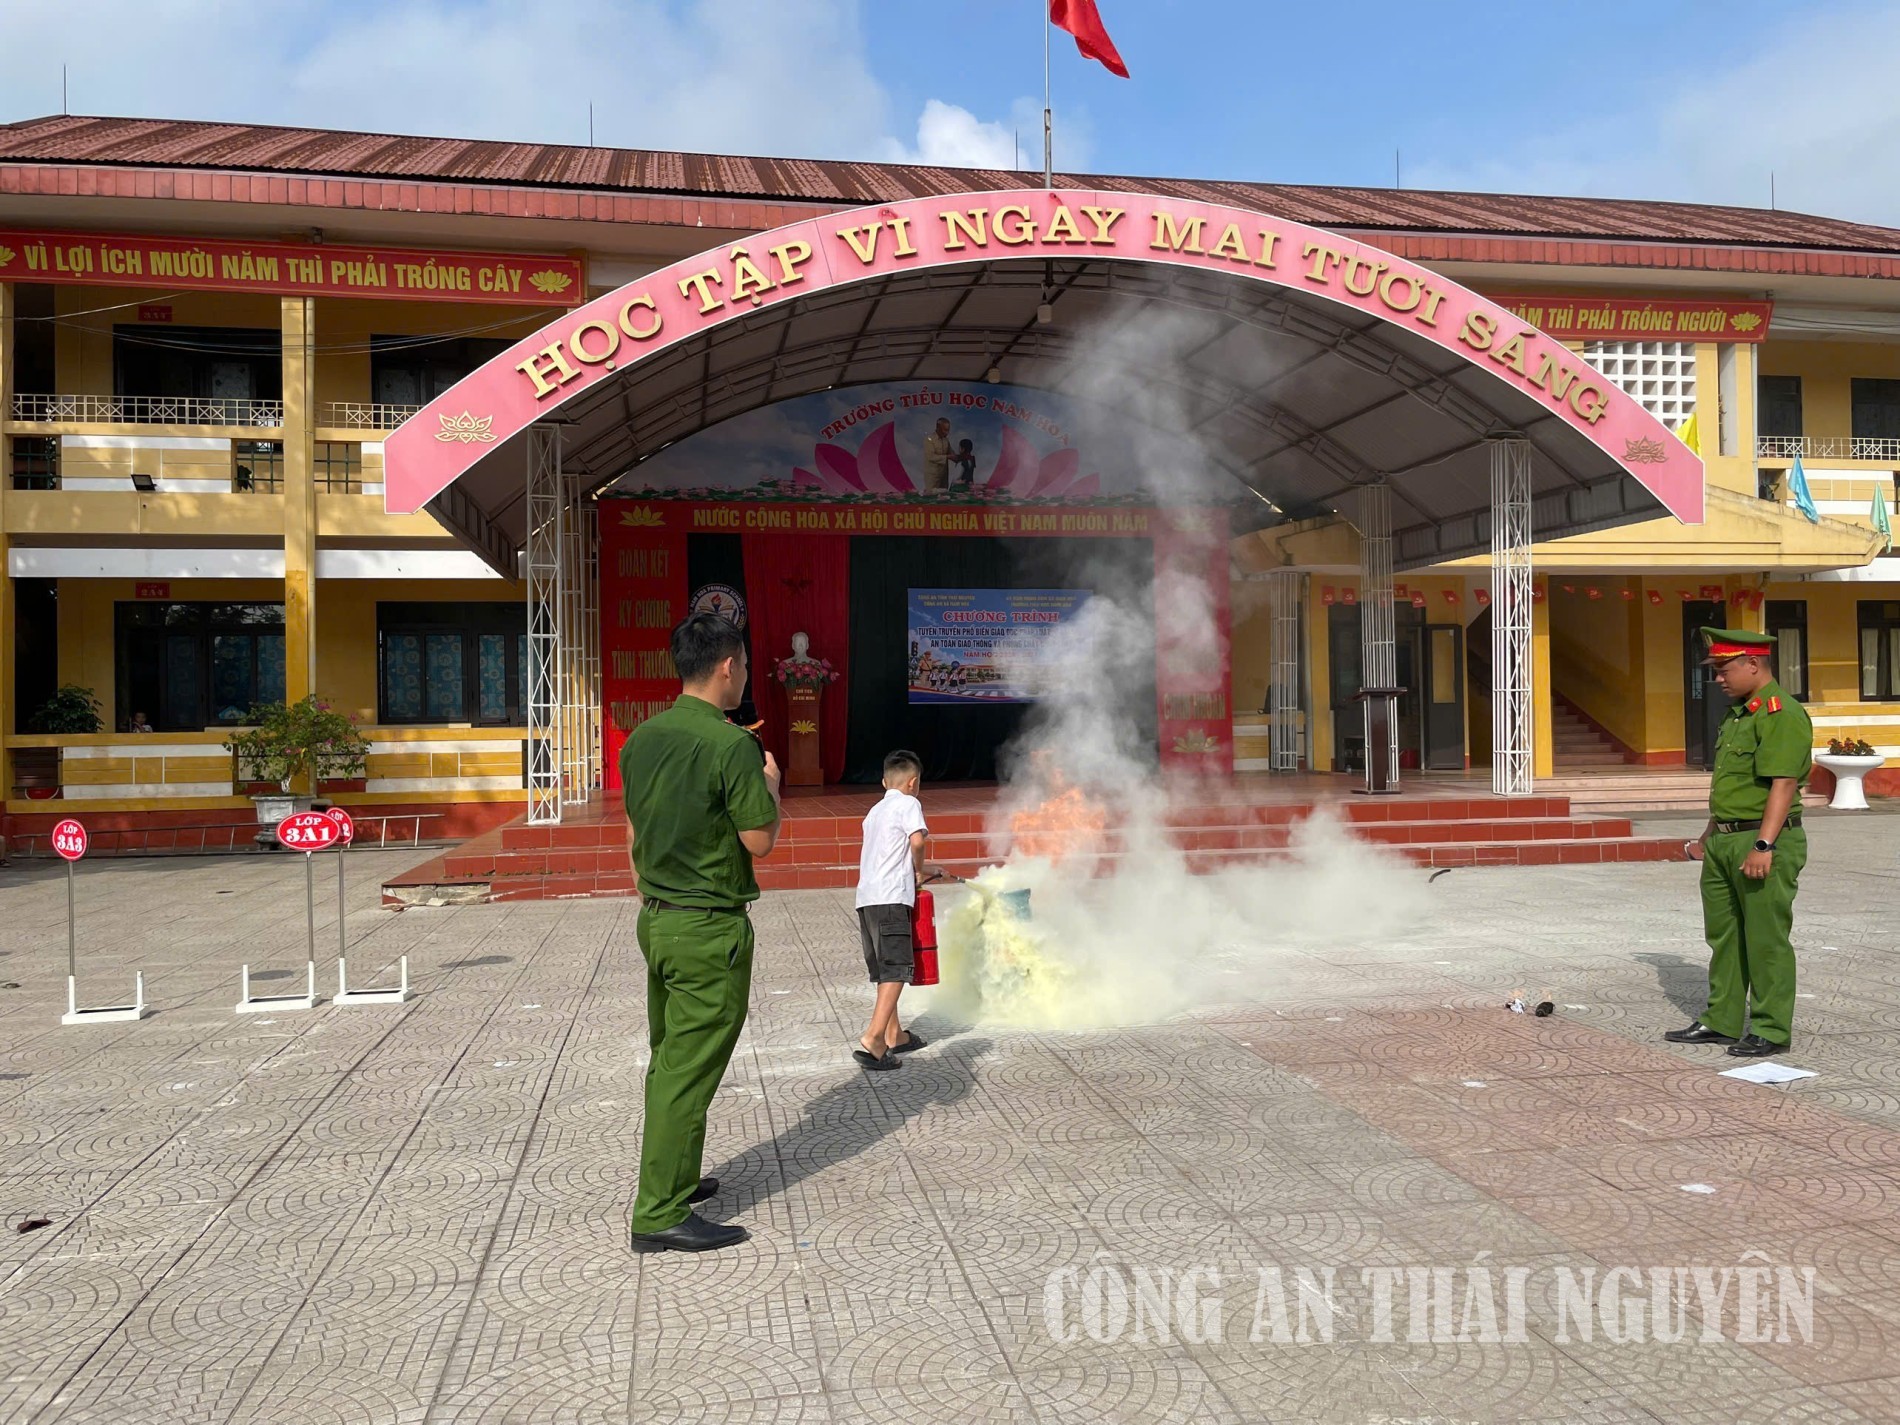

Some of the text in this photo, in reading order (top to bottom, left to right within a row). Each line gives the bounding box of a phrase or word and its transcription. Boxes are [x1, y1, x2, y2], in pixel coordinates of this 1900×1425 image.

[23, 240, 523, 292] VÌ LỢI ÍCH MƯỜI NĂM THÌ PHẢI TRỒNG CÂY
[514, 292, 664, 400] HỌC
[677, 239, 814, 316] TẬP
[1149, 210, 1283, 270] MAI
[1301, 240, 1447, 328] TƯƠI
[1457, 307, 1610, 426] SÁNG
[1548, 303, 1574, 329] THÌ
[1576, 303, 1616, 330] PHẢI
[1620, 305, 1674, 331] TRỒNG
[1677, 307, 1727, 332] NGƯỜI
[819, 398, 896, 441] TRƯỜNG
[900, 386, 944, 409] TIỂU
[948, 391, 987, 409] HỌC
[992, 398, 1033, 423] NAM
[693, 506, 1148, 534] NƯỚC CỘNG HÒA XÃ HỘI CHỦ NGHĨA VIỆT NAM MUÔN NĂM
[942, 608, 1061, 623] CHƯƠNG TRÌNH
[63, 824, 78, 834] LỚP
[295, 816, 322, 826] LỚP
[57, 834, 83, 852] 3A3
[285, 827, 331, 842] 3A1
